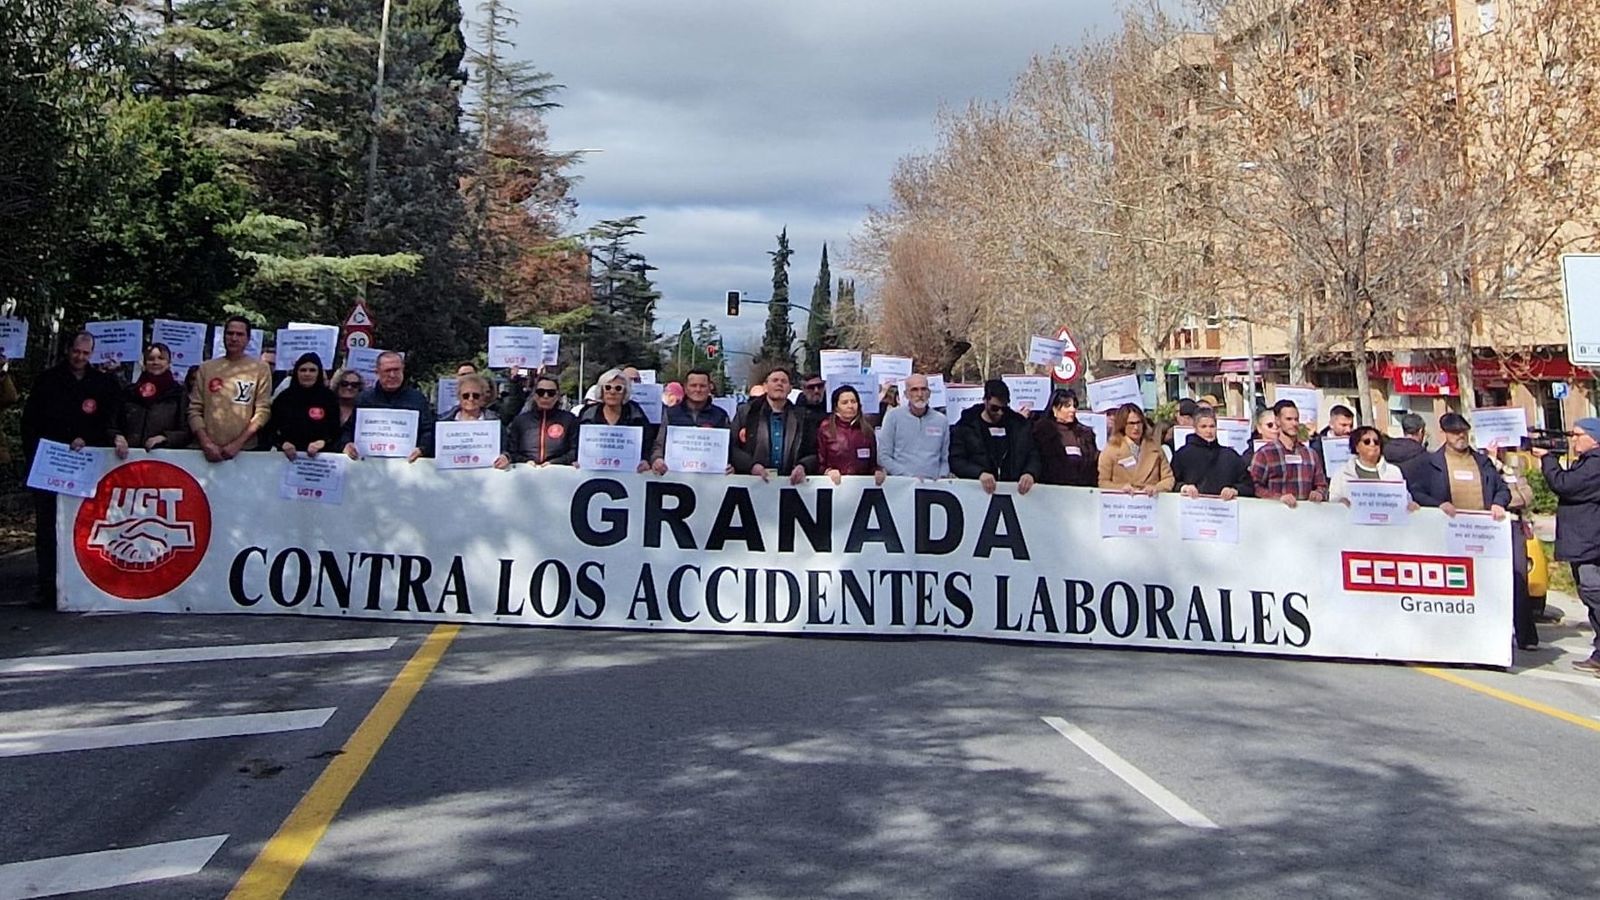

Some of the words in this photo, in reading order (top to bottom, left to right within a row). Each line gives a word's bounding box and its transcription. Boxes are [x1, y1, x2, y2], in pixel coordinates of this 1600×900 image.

[350, 337, 366, 347] 30
[453, 455, 471, 463] UGT
[595, 457, 612, 465] UGT
[297, 488, 314, 496] UGT
[109, 487, 184, 521] UGT
[570, 478, 1031, 561] GRANADA
[228, 545, 473, 614] CONTRA
[495, 557, 606, 620] LOS
[627, 562, 973, 628] ACCIDENTES
[994, 575, 1312, 648] LABORALES
[1400, 596, 1475, 615] Granada
